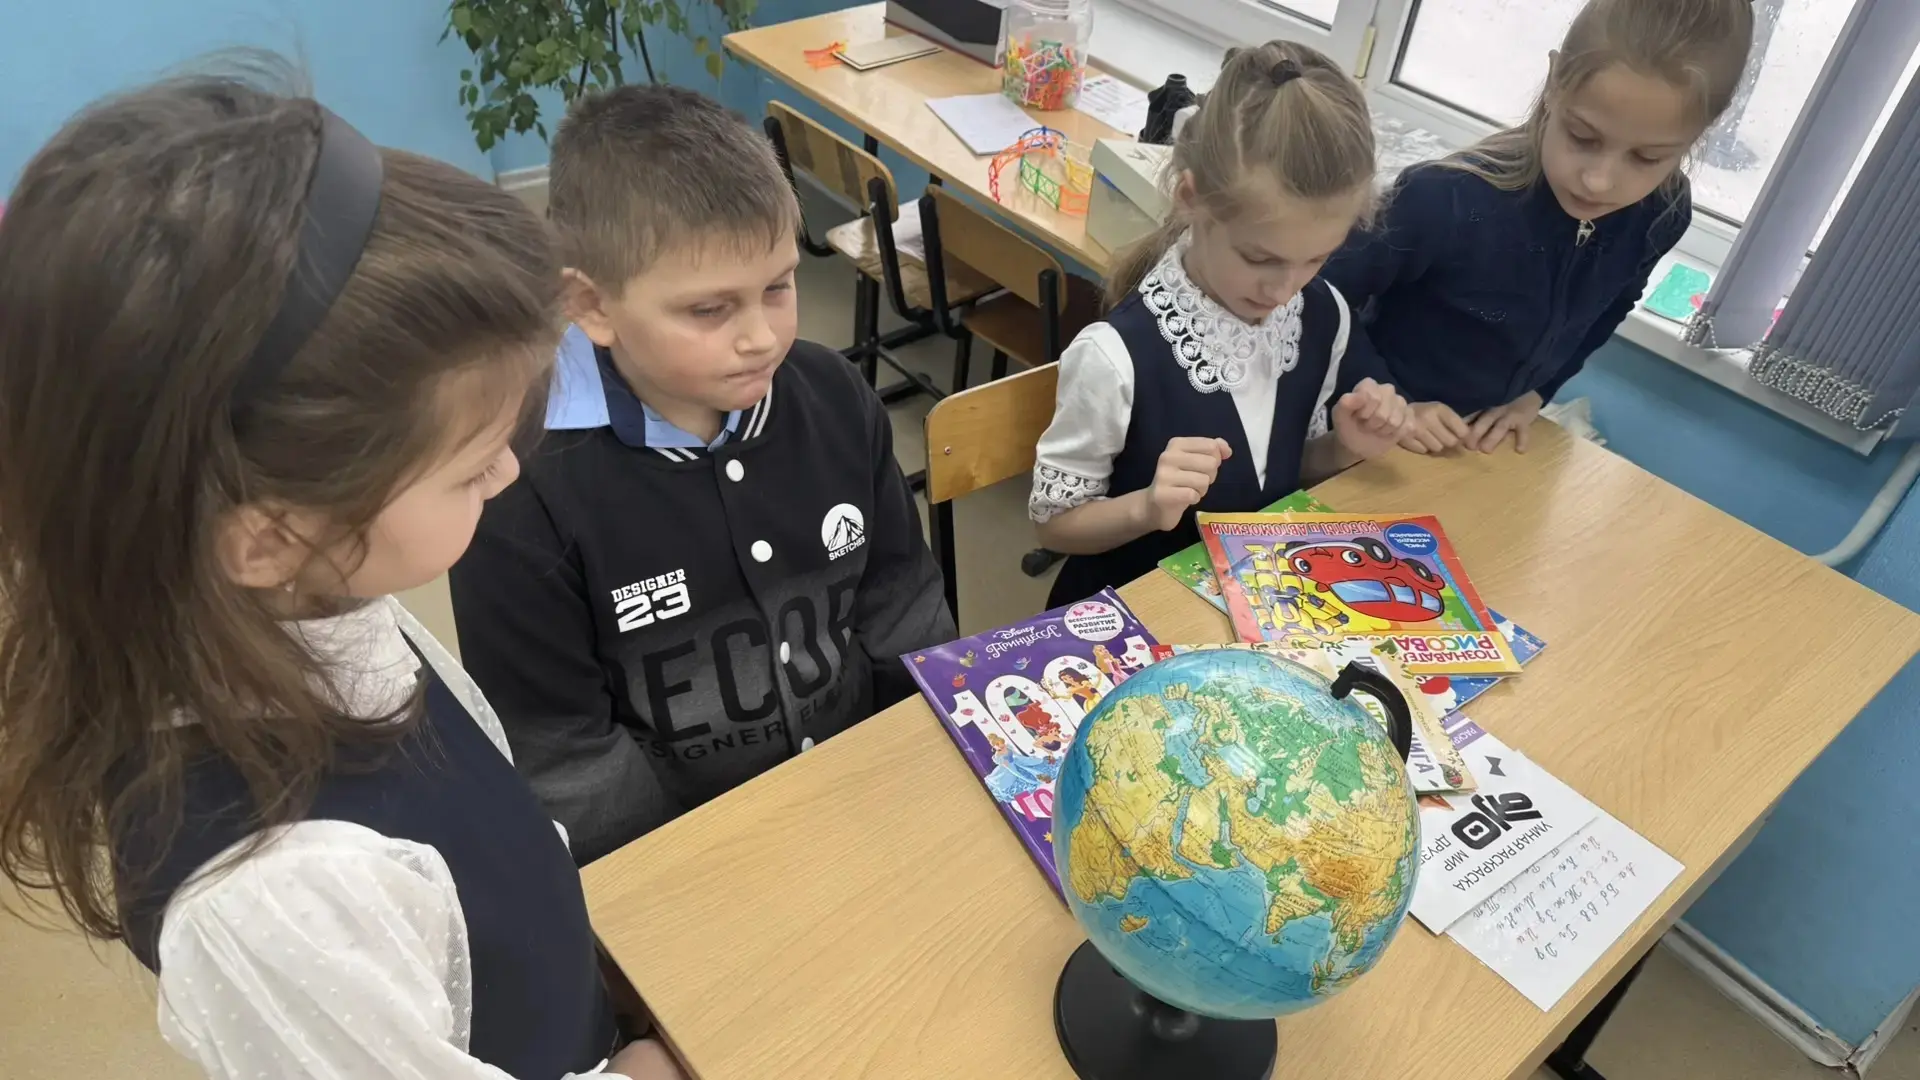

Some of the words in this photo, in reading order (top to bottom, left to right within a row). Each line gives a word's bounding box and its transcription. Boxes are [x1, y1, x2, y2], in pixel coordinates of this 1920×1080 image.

[1209, 521, 1308, 536] АВТОМОБИЛИ
[1320, 521, 1380, 535] РОБОТЫ
[828, 534, 866, 561] SKETCHES
[611, 568, 687, 603] DESIGNER
[614, 582, 692, 633] 23
[1073, 618, 1118, 629] РАЗВИТИЕ
[985, 624, 1063, 659] ПРИНЦЕССА
[1451, 727, 1479, 745] РАСКР
[1512, 821, 1553, 850] УМНАЯ
[1444, 849, 1470, 872] МИР
[1453, 845, 1517, 892] РАСКРАСКА
